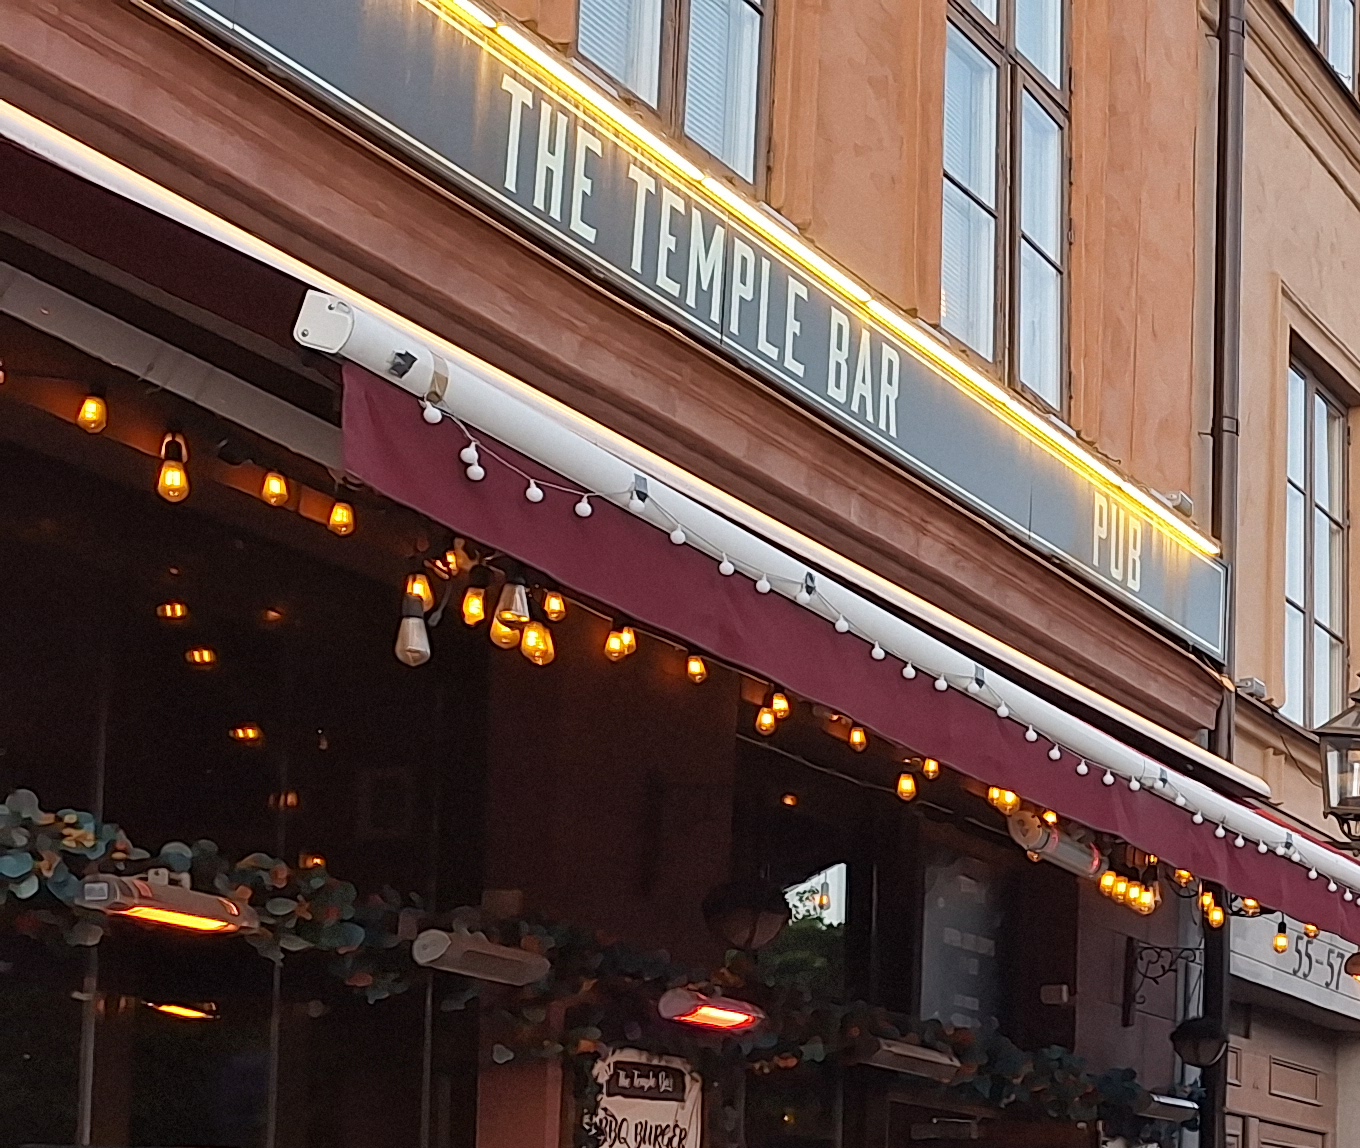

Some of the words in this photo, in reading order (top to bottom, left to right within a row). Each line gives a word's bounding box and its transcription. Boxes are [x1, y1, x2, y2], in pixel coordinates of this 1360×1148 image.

[501, 73, 603, 244] THE
[627, 163, 809, 378] TEMPLE
[826, 305, 901, 439] BAR
[1092, 490, 1142, 593] PUB
[1292, 934, 1346, 991] 55-57
